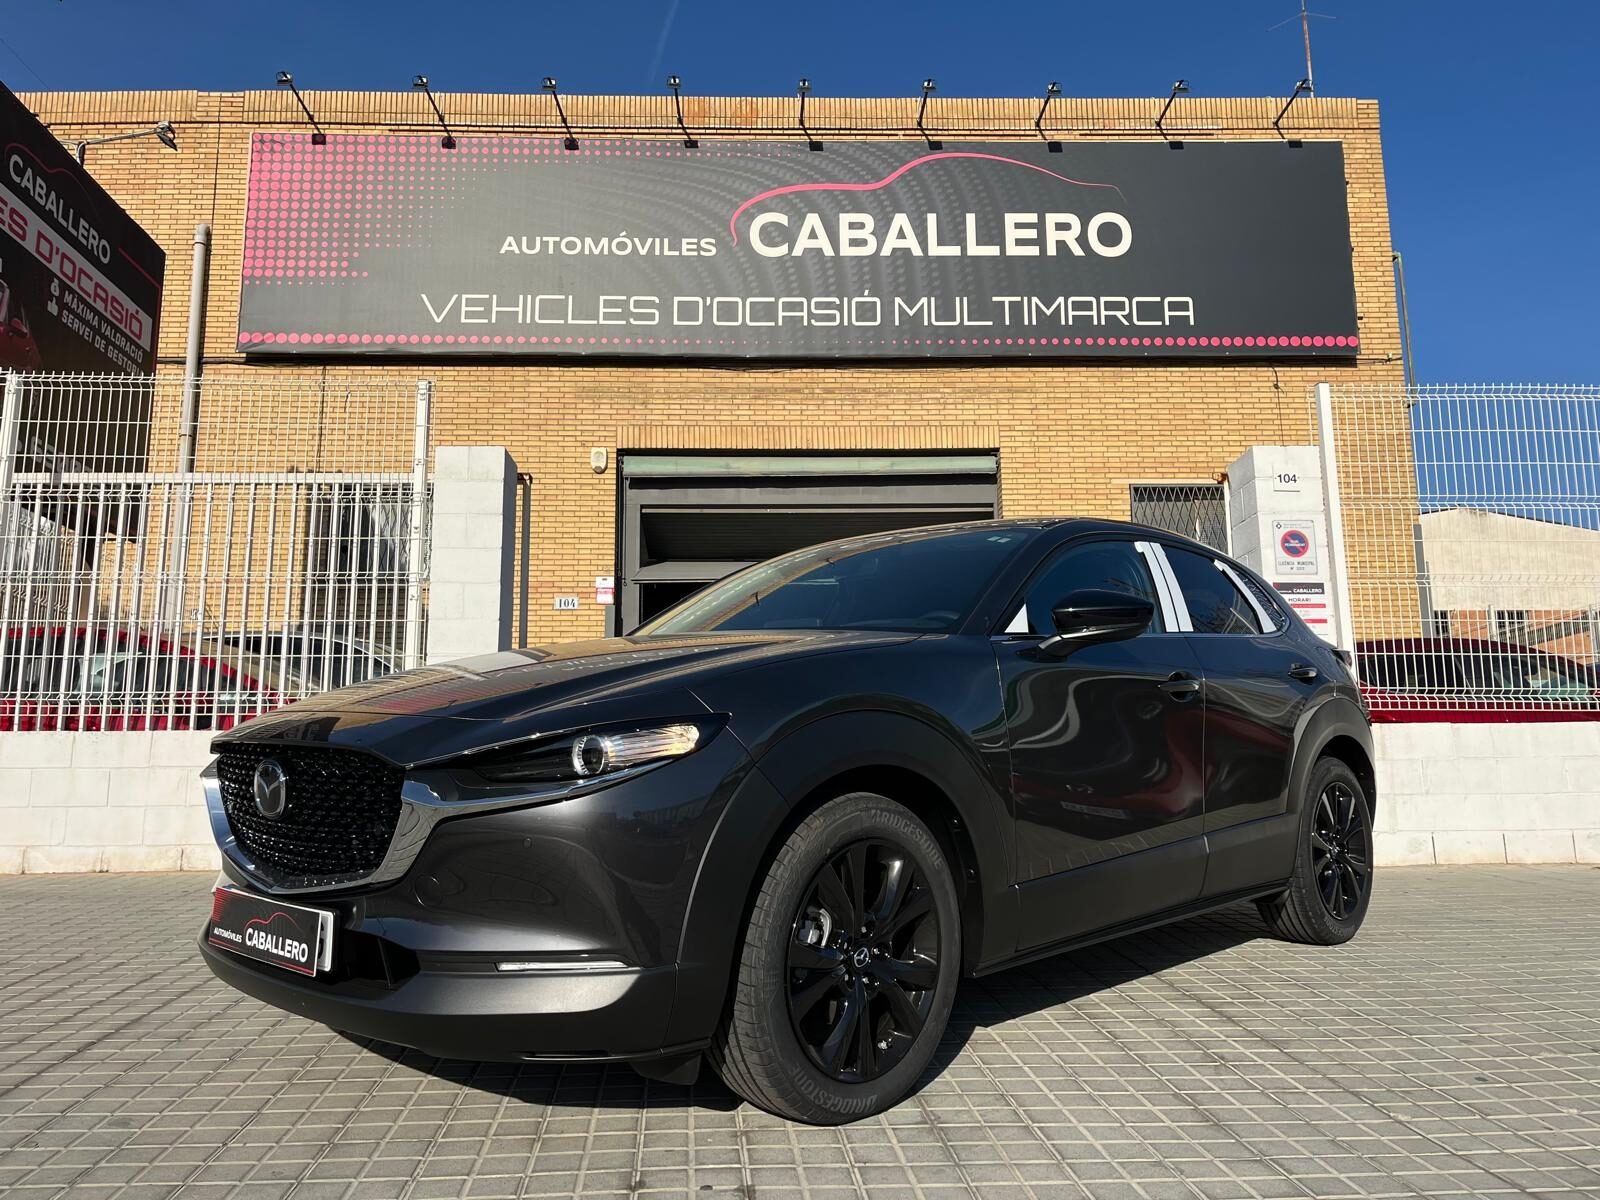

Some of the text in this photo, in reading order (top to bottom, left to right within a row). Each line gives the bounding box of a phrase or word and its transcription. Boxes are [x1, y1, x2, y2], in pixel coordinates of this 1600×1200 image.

[9, 154, 111, 264] CABALLERO
[500, 211, 1133, 258] AUTOMÓVILES CABALLERO
[421, 289, 1195, 326] VEHICLES D'OCASIÓ MULTIMARCA
[61, 310, 93, 343] SERVEI
[94, 337, 107, 353] DE
[100, 319, 144, 364] VALORACIÓ
[1277, 473, 1297, 483] 104
[559, 598, 575, 607] 104
[870, 808, 944, 870] BRIDGESTONE
[213, 927, 243, 943] AUTOMÓVILES
[245, 927, 309, 963] CABALLERO
